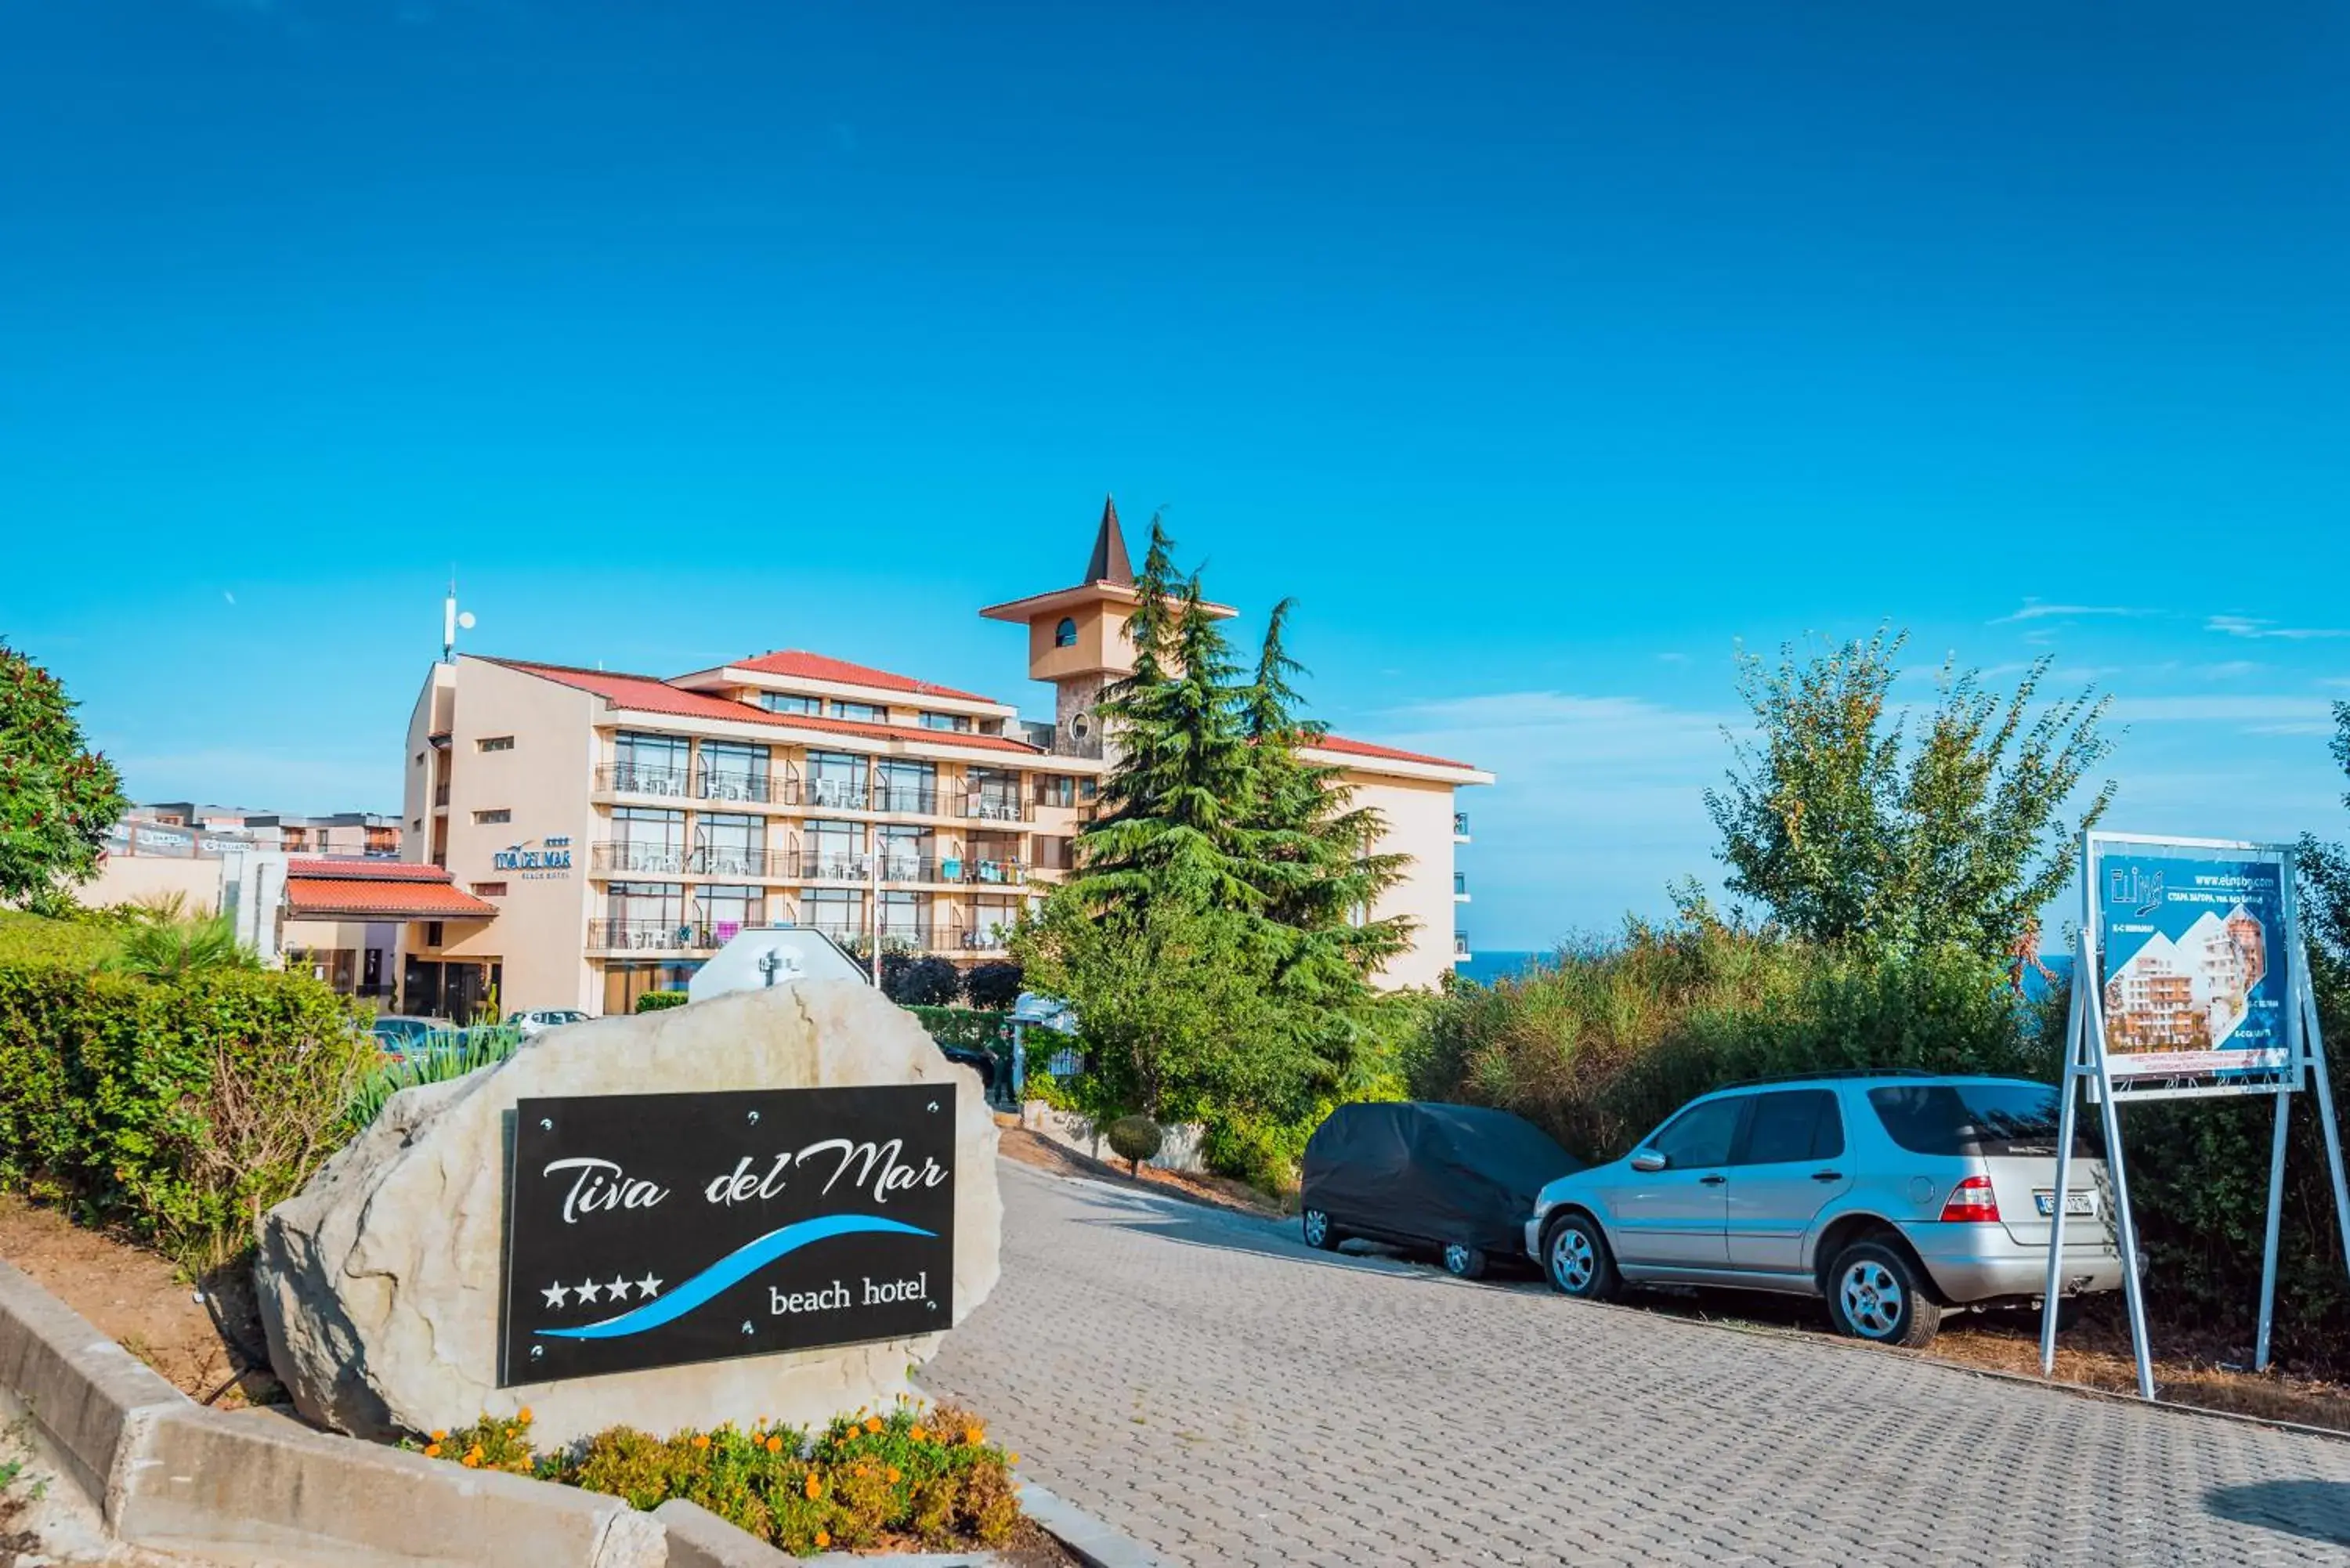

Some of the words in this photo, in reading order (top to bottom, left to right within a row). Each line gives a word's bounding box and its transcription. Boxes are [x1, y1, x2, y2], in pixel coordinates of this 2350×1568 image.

[543, 1157, 670, 1224] Tiva
[704, 1152, 792, 1208] del
[794, 1138, 949, 1204] Mar
[768, 1280, 851, 1316] beach
[862, 1271, 928, 1306] hotel
